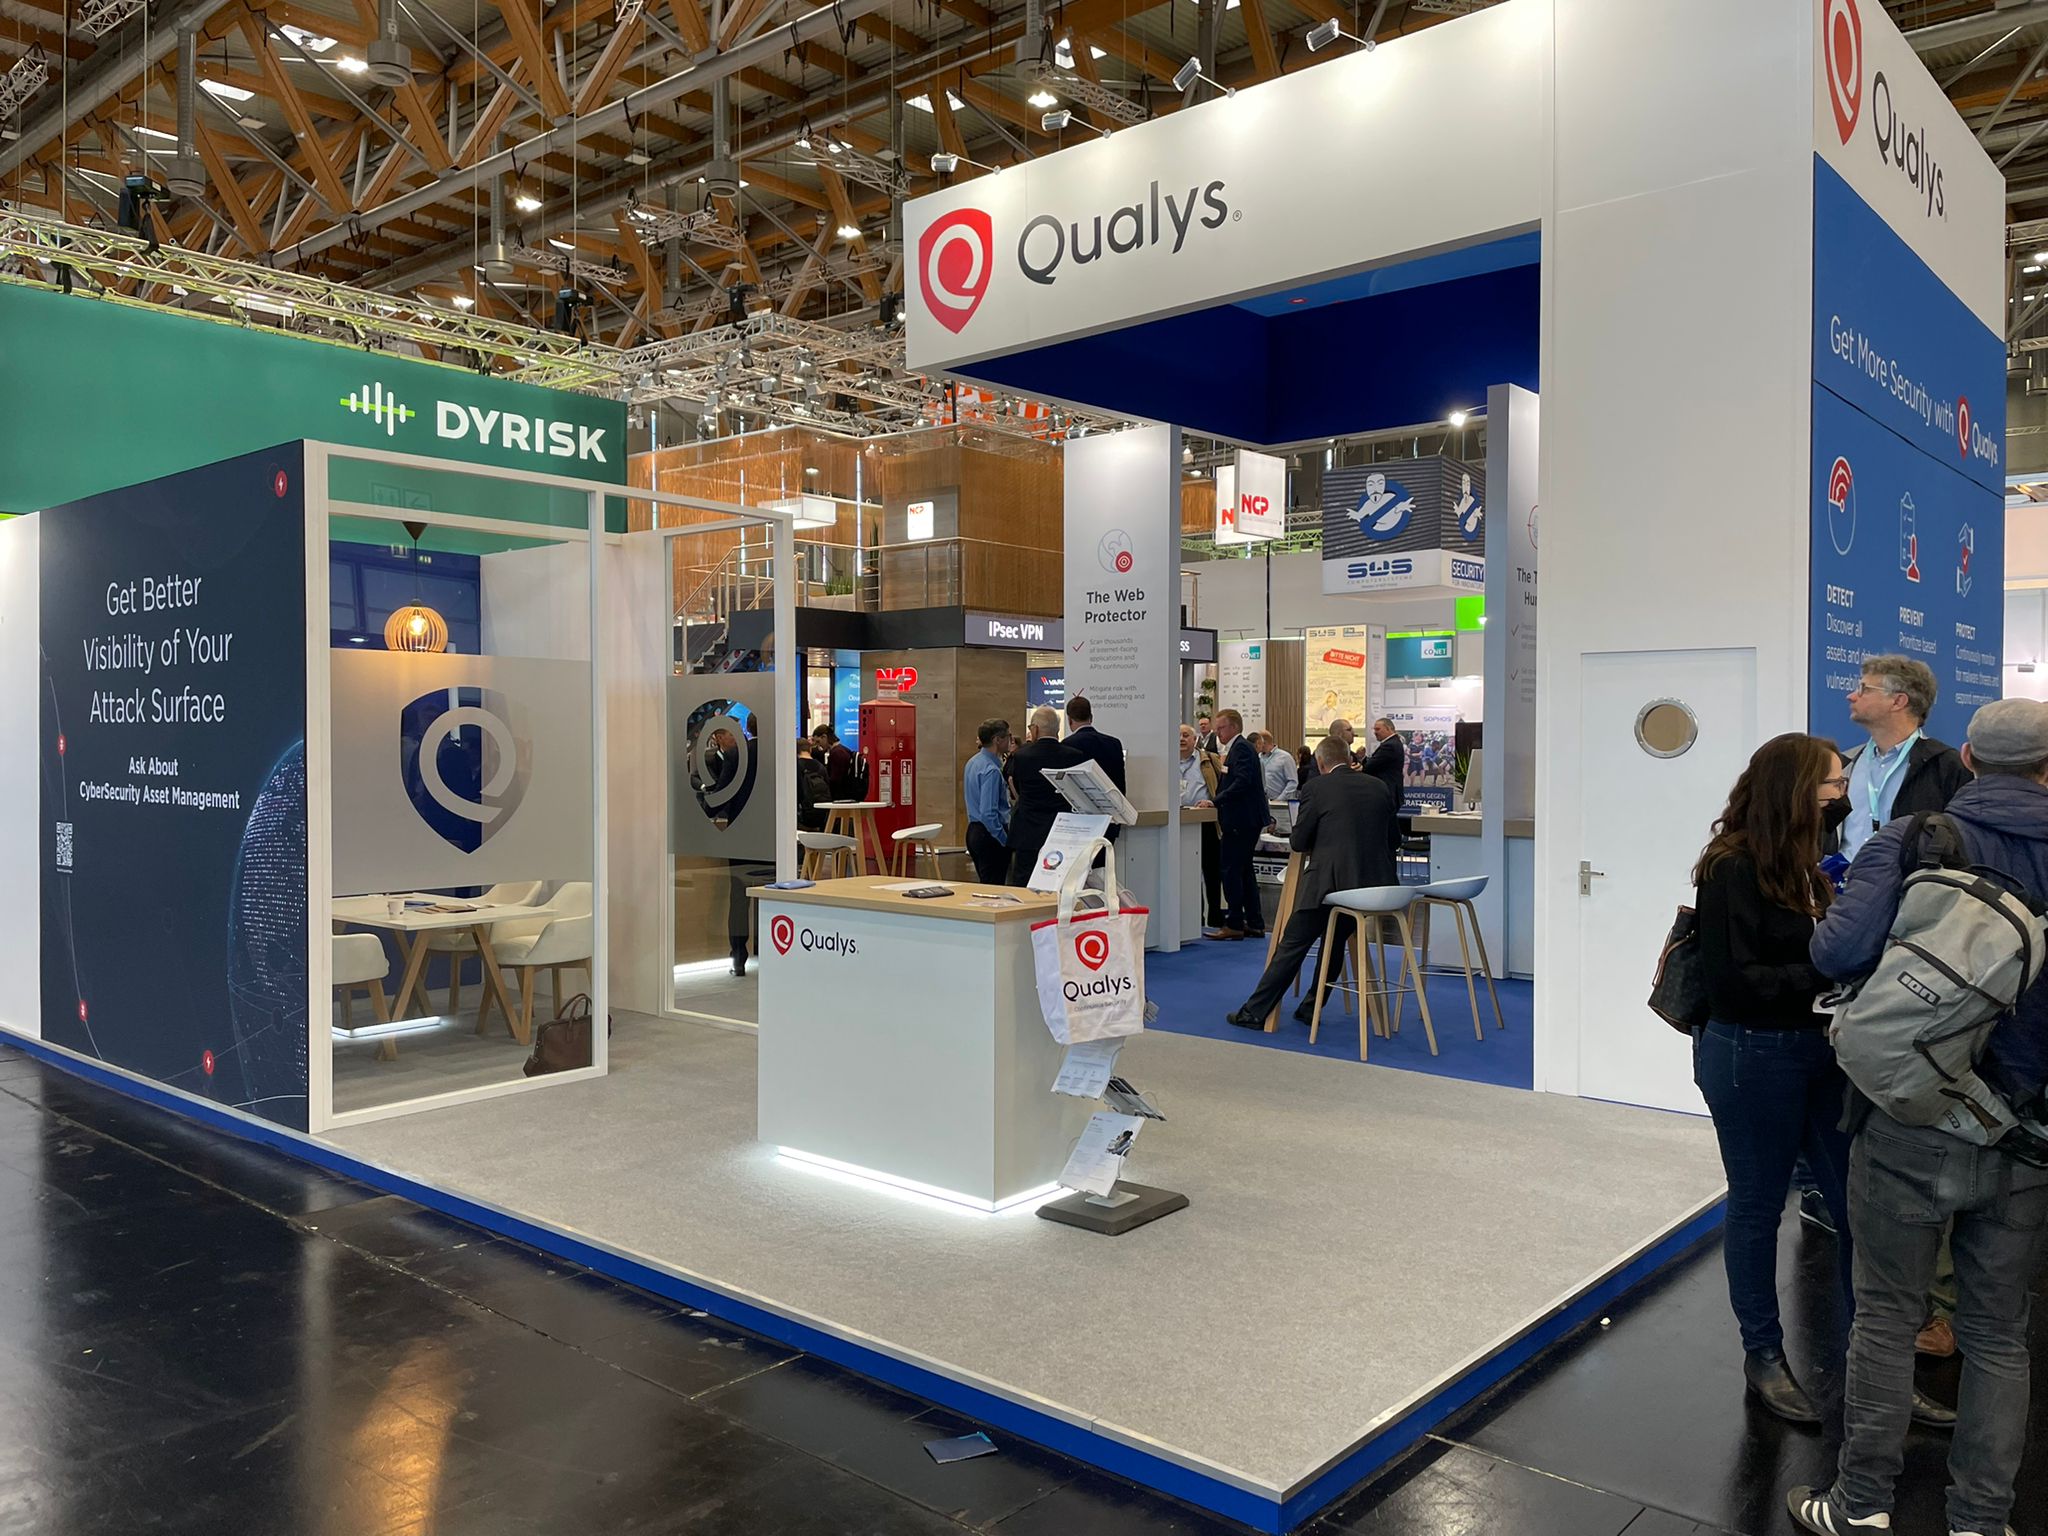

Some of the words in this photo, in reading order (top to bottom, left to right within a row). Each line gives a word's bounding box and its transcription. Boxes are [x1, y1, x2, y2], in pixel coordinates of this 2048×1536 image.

[1873, 71, 1943, 217] Qualys
[1018, 180, 1228, 285] Qualys
[1830, 315, 1854, 364] Get
[1857, 333, 1887, 387] More
[1890, 360, 1932, 426] Security
[1934, 400, 1954, 436] with
[1972, 422, 1998, 468] Qualys
[437, 400, 607, 463] DYRISK
[1222, 508, 1234, 525] N
[1242, 494, 1269, 516] NCP
[1453, 561, 1484, 580] SECURITY
[1517, 567, 1531, 584] The
[107, 581, 136, 616] Get
[143, 574, 202, 611] Better
[1086, 591, 1110, 604] The
[1115, 588, 1145, 602] Web
[1826, 584, 1854, 608] DETECT
[1085, 609, 1147, 623] Protector
[1826, 613, 1853, 636] Discover
[1854, 620, 1863, 638] all
[1900, 606, 1924, 627] PREVENT
[989, 621, 1018, 639] IPsec
[1020, 624, 1043, 640] VPN
[1956, 622, 1976, 640] PROTECT
[83, 633, 154, 674] Visibility
[161, 628, 180, 666] of
[185, 628, 232, 664] Your
[1826, 645, 1846, 662] assets
[1847, 648, 1860, 664] and
[1900, 631, 1922, 652] Prioritize
[1922, 637, 1936, 655] based
[89, 688, 146, 723] Attack
[151, 685, 225, 723] Surface
[128, 756, 146, 775] Ask
[148, 757, 178, 776] About
[80, 781, 141, 806] CyberSecurity
[143, 785, 169, 805] Asset
[172, 786, 240, 810] Management
[800, 928, 857, 956] Qualys
[1063, 975, 1131, 1001] Qualys
